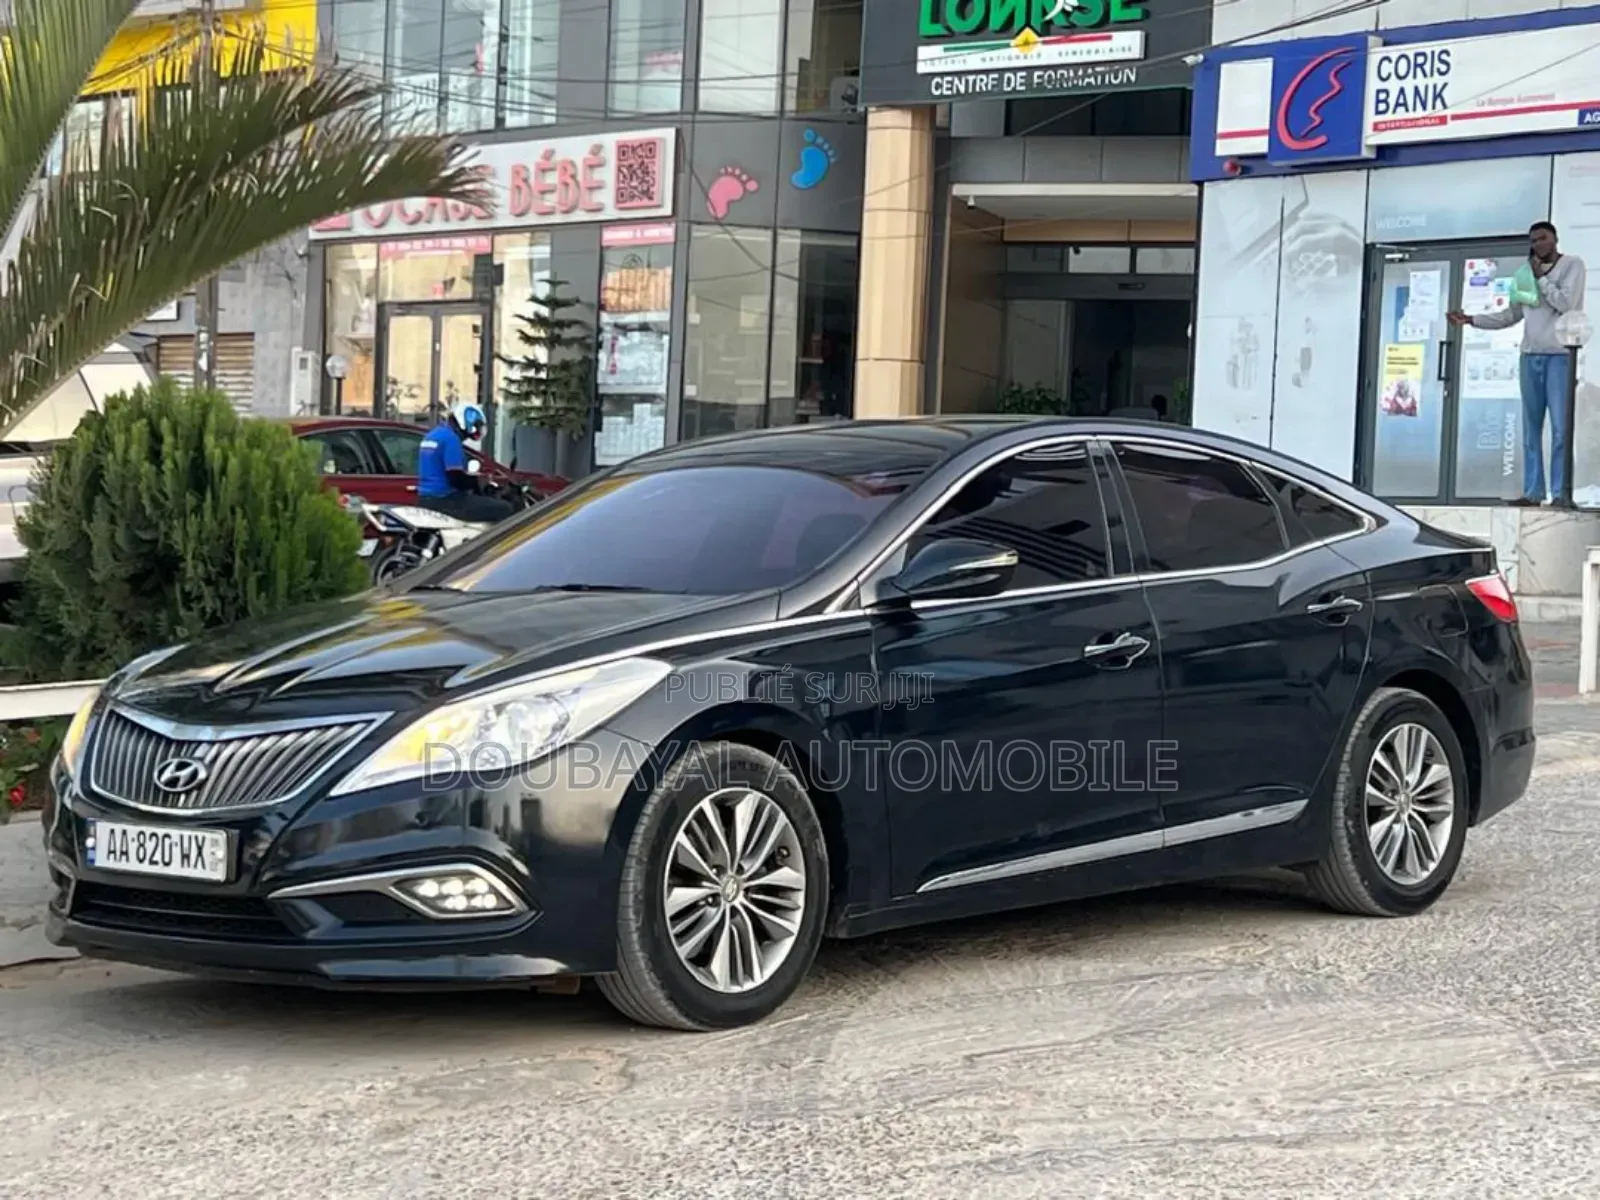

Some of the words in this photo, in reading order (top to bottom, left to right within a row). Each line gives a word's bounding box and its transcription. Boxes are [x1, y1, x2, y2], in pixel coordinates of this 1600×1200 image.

[931, 74, 999, 95] CENTRE
[1003, 72, 1026, 91] DE
[1033, 67, 1137, 88] FORMATION
[1377, 49, 1452, 82] CORIS
[1375, 83, 1448, 115] BANK
[510, 144, 605, 216] BÉBÉ
[1502, 411, 1516, 476] WELCOME
